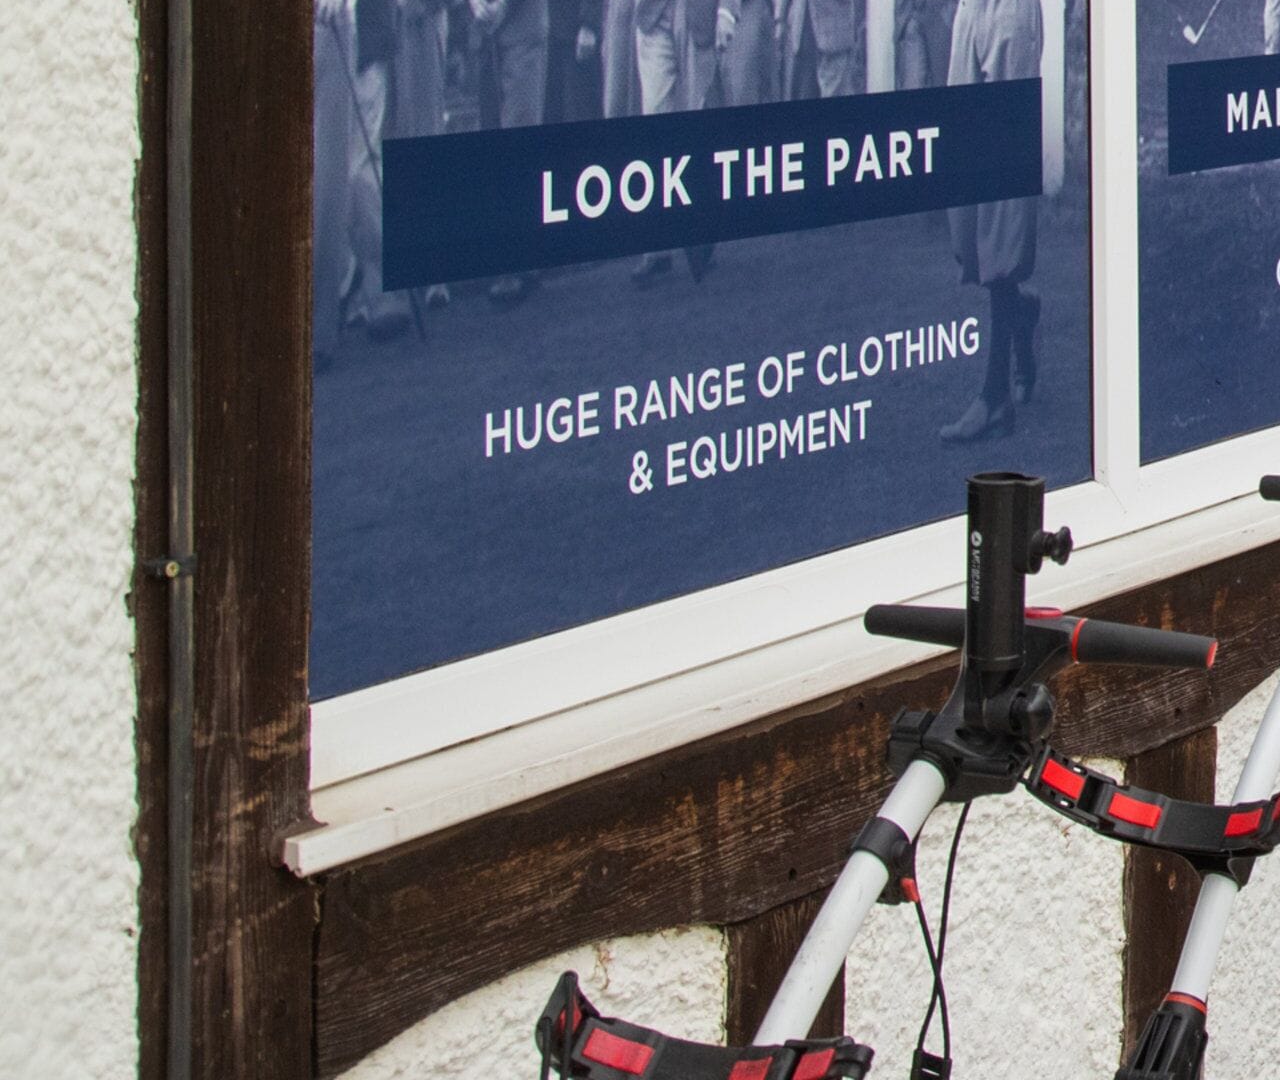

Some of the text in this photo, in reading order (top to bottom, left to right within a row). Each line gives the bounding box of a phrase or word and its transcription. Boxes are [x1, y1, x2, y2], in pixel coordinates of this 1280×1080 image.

[542, 127, 940, 224] LOOK THE PART
[484, 317, 981, 458] HUGE RANGE OF CLOTHING
[628, 400, 873, 495] & EQUIPMENT
